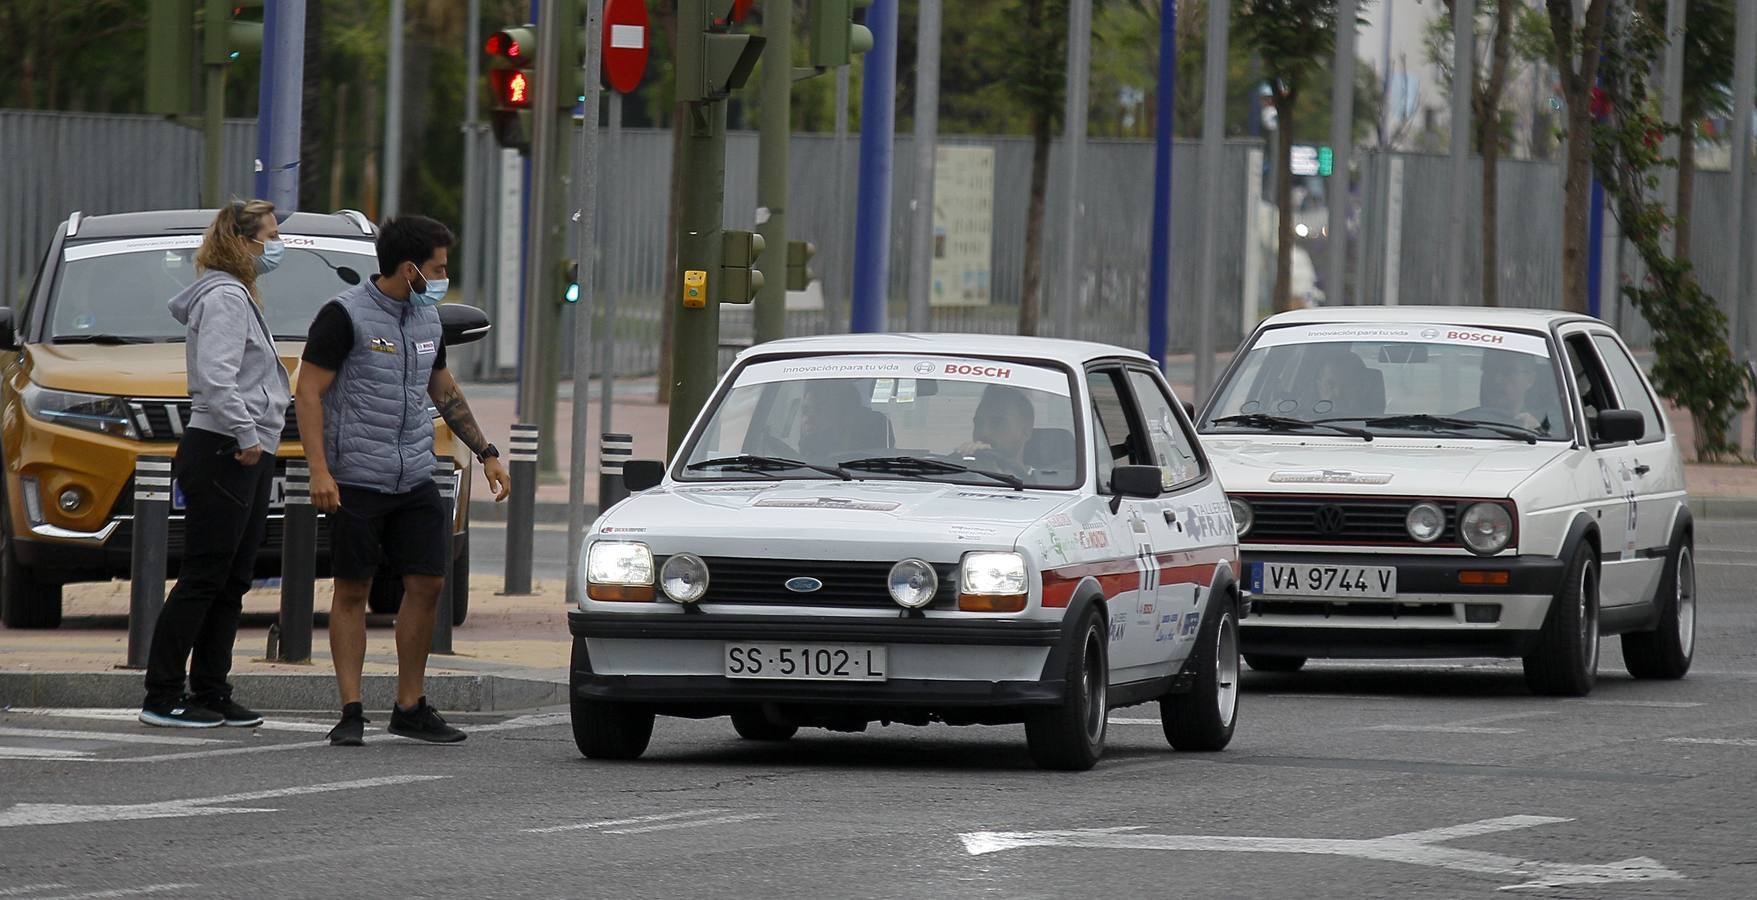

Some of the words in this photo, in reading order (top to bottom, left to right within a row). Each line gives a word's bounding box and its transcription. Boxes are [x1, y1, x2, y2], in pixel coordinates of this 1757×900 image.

[1307, 328, 1356, 337] Innovación
[1447, 330, 1504, 344] BOSCH
[783, 363, 838, 374] Innovación
[838, 364, 863, 374] para
[865, 363, 878, 371] tu
[880, 363, 899, 371] vida
[944, 363, 1011, 378] BOSCH
[1271, 566, 1299, 589] VA
[1308, 567, 1368, 592] 9744
[1378, 569, 1391, 593] V
